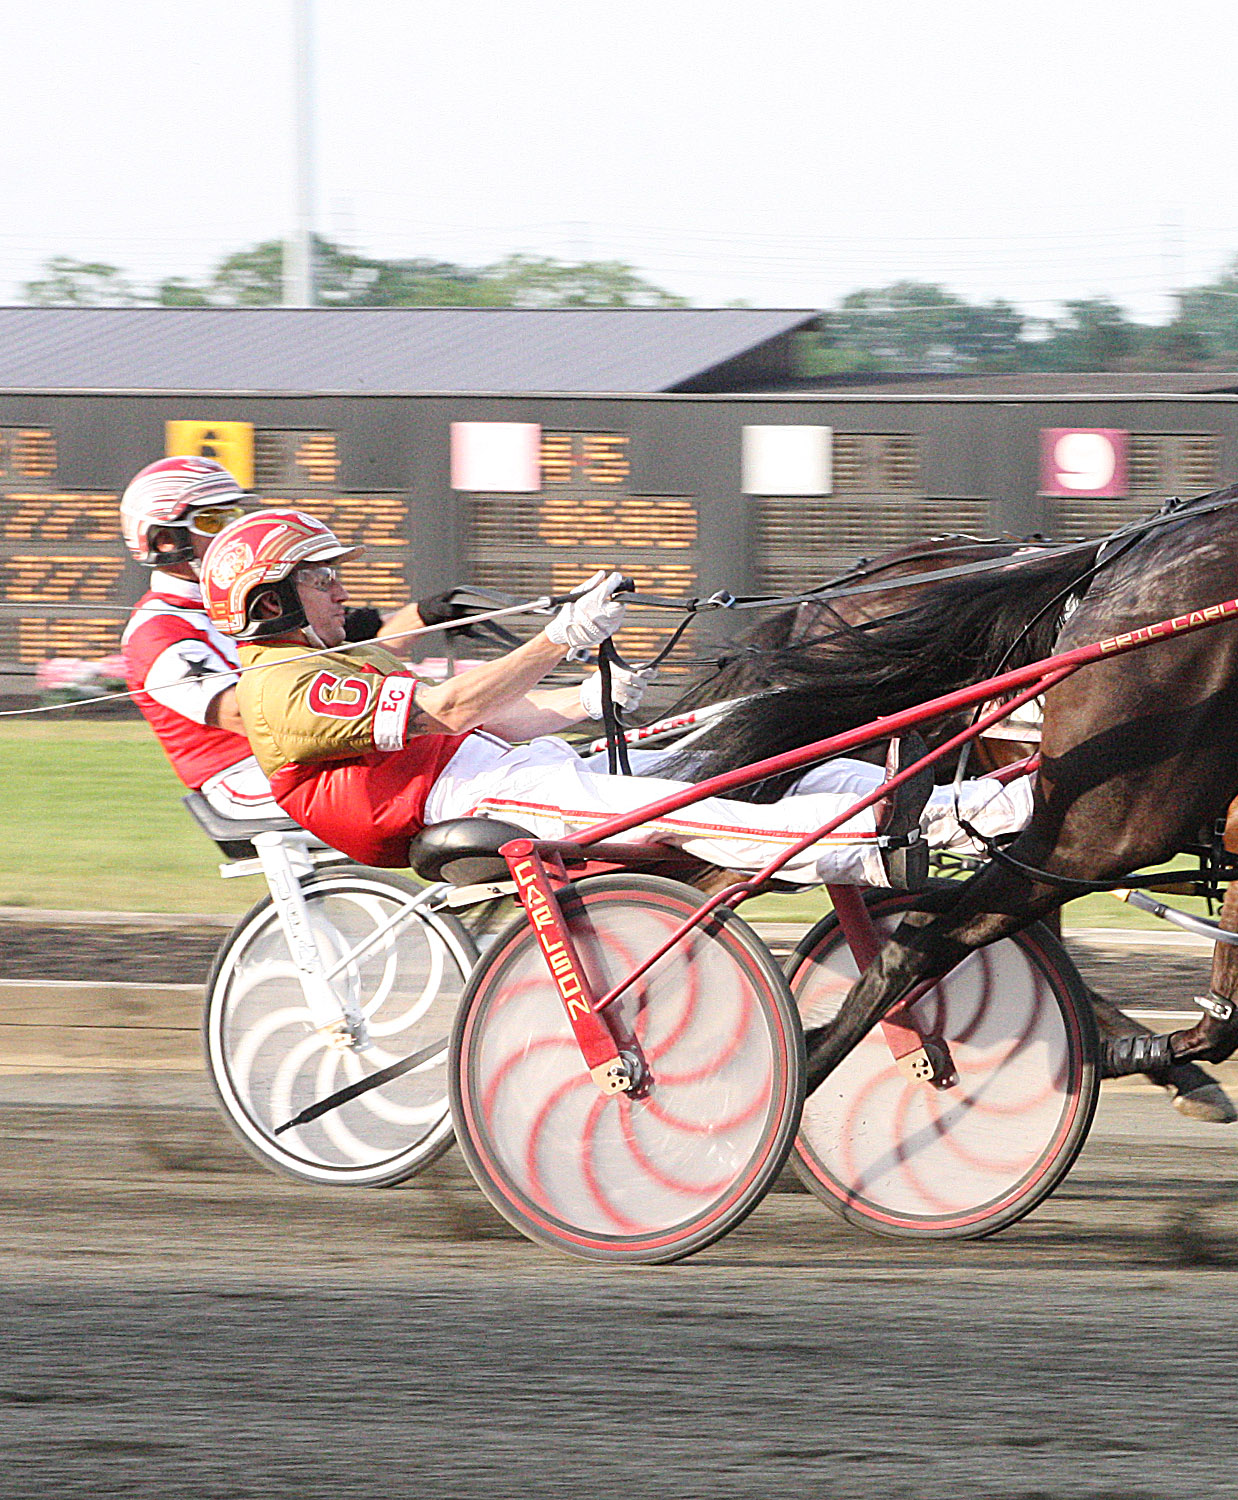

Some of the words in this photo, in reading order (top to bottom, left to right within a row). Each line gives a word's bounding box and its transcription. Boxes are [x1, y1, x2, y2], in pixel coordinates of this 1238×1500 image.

[1053, 432, 1117, 491] 9
[1100, 623, 1165, 653] ERIC
[381, 689, 406, 713] EC
[513, 860, 591, 1021] CARLSON
